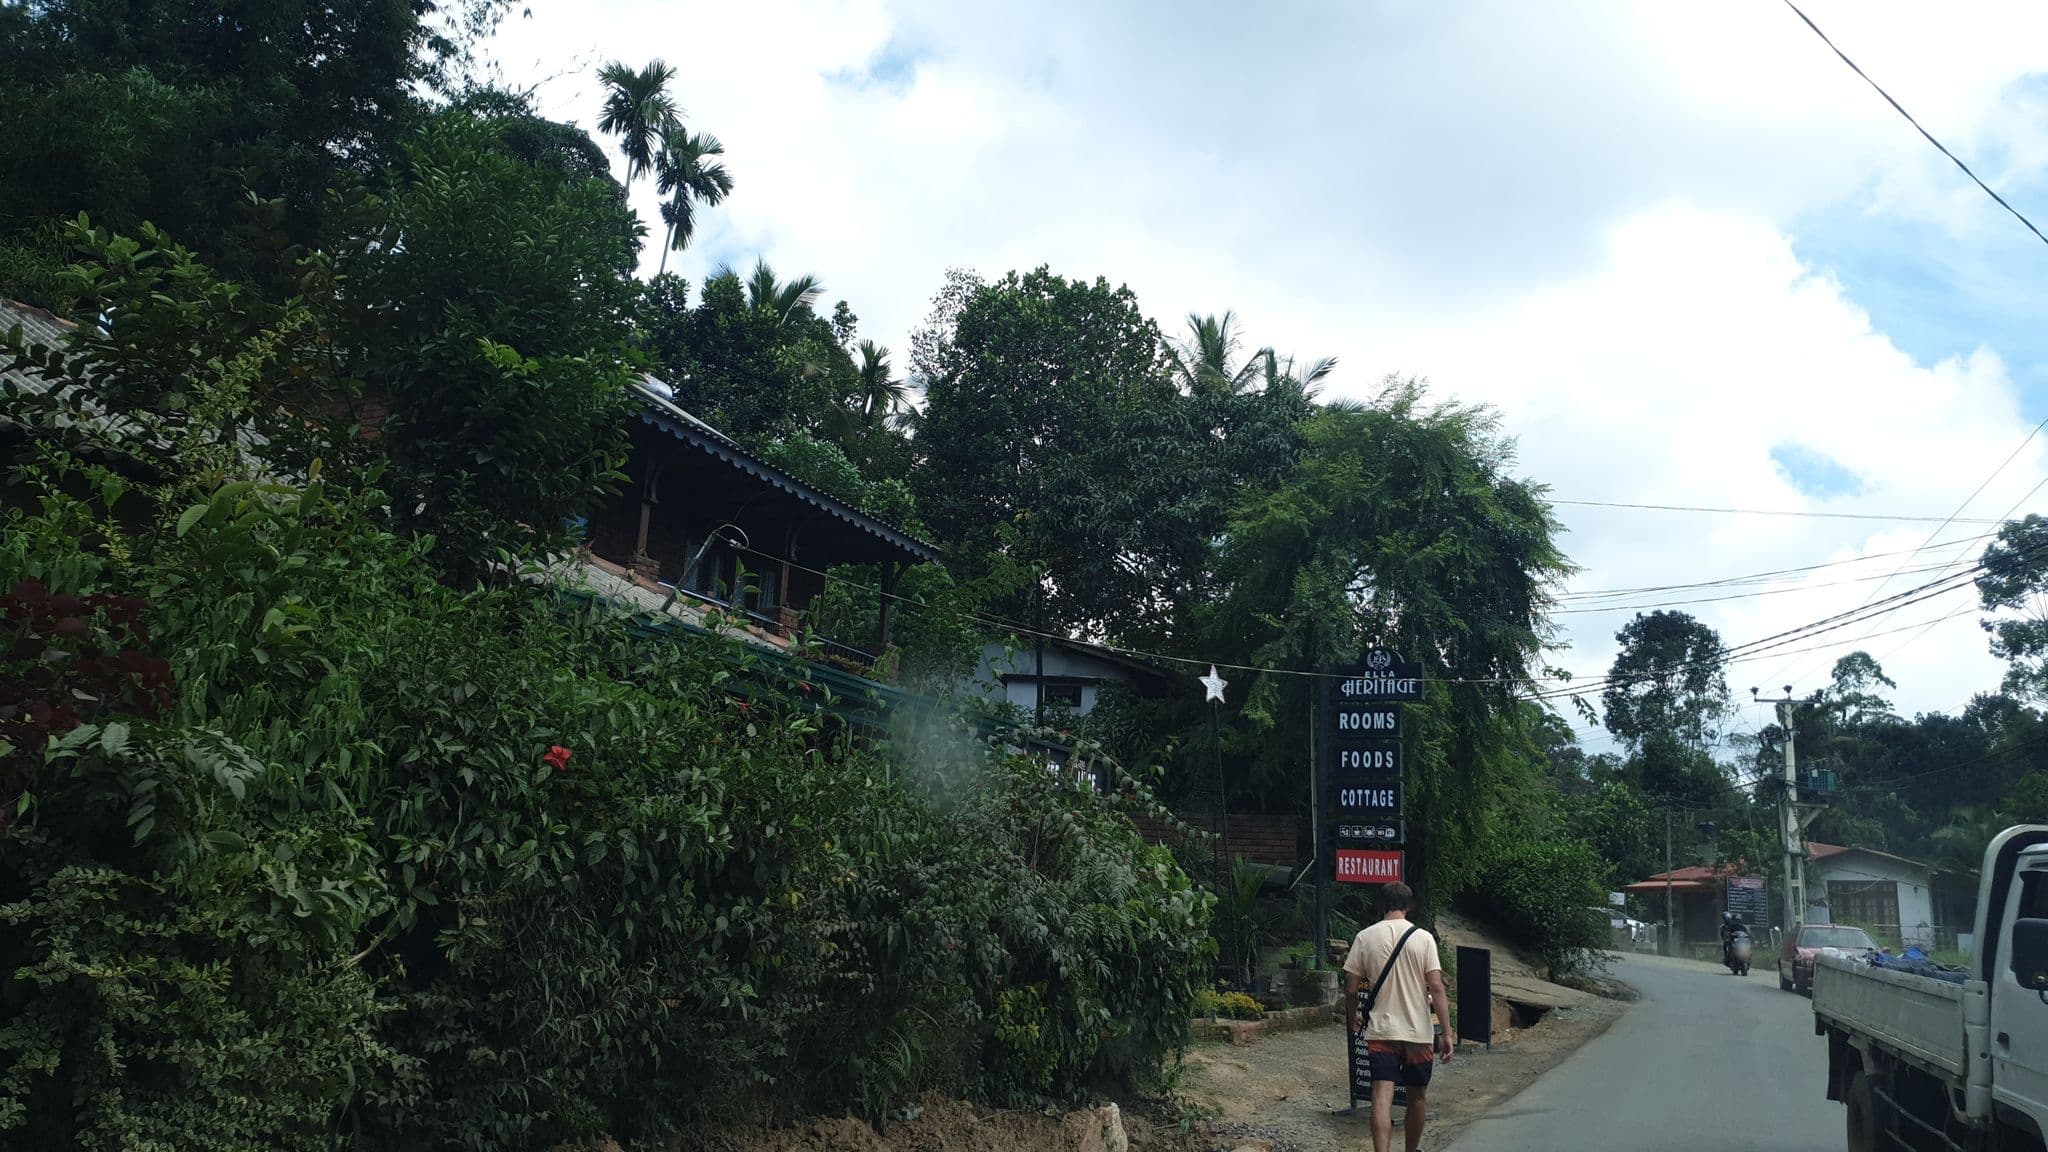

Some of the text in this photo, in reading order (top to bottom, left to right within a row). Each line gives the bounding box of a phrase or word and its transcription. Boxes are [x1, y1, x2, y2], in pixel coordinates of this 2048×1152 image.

[1364, 670, 1396, 679] ELLA
[1340, 678, 1417, 697] HERITAGE
[1339, 712, 1396, 730] ROOMS
[1341, 751, 1394, 768] FOODS
[1340, 789, 1394, 807] COTTAGE
[1338, 857, 1399, 876] RESTAURANT
